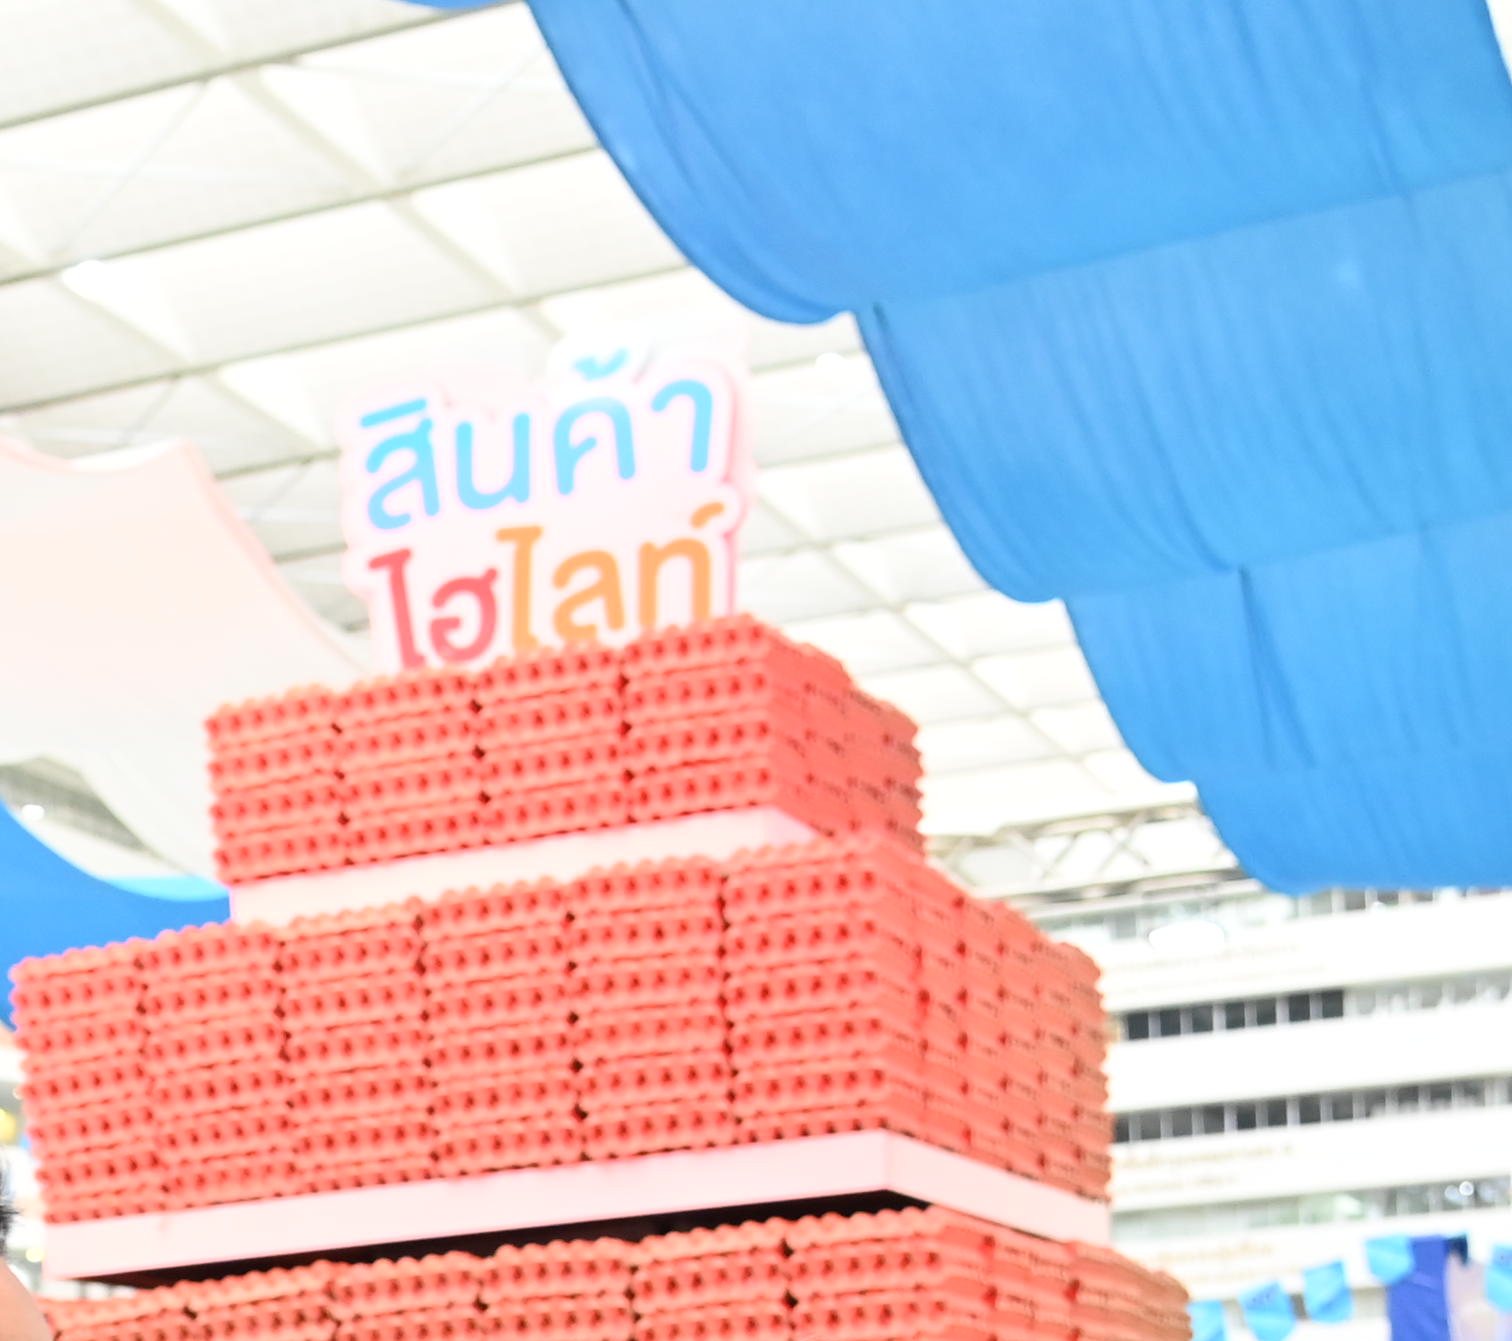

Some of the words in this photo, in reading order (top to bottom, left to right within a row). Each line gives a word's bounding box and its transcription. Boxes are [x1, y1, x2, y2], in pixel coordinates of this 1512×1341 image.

[360, 347, 714, 531] สินค้า
[368, 501, 726, 671] ไฮไลท์
